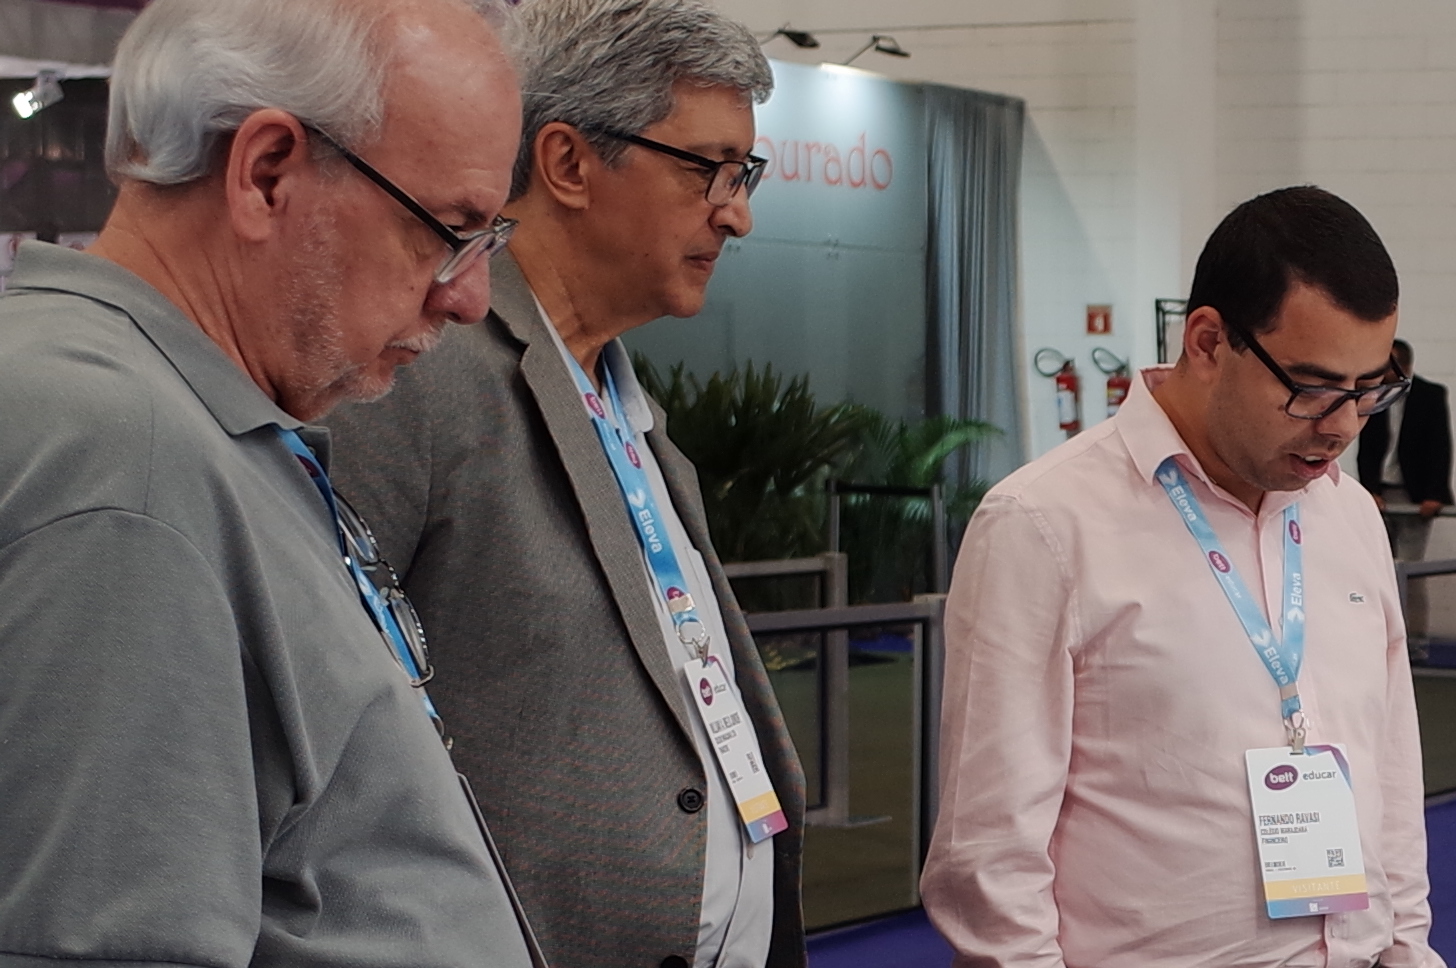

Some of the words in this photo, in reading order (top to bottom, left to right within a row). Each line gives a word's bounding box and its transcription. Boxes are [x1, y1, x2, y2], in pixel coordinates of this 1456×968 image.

[1171, 485, 1197, 522] Eleva
[638, 508, 663, 554] Eleva
[1290, 572, 1303, 607] Eleva
[1263, 646, 1289, 686] Eleva
[1302, 770, 1337, 781] educar
[1259, 813, 1295, 827] FERNANDO
[1292, 880, 1342, 894] VISITANTE
